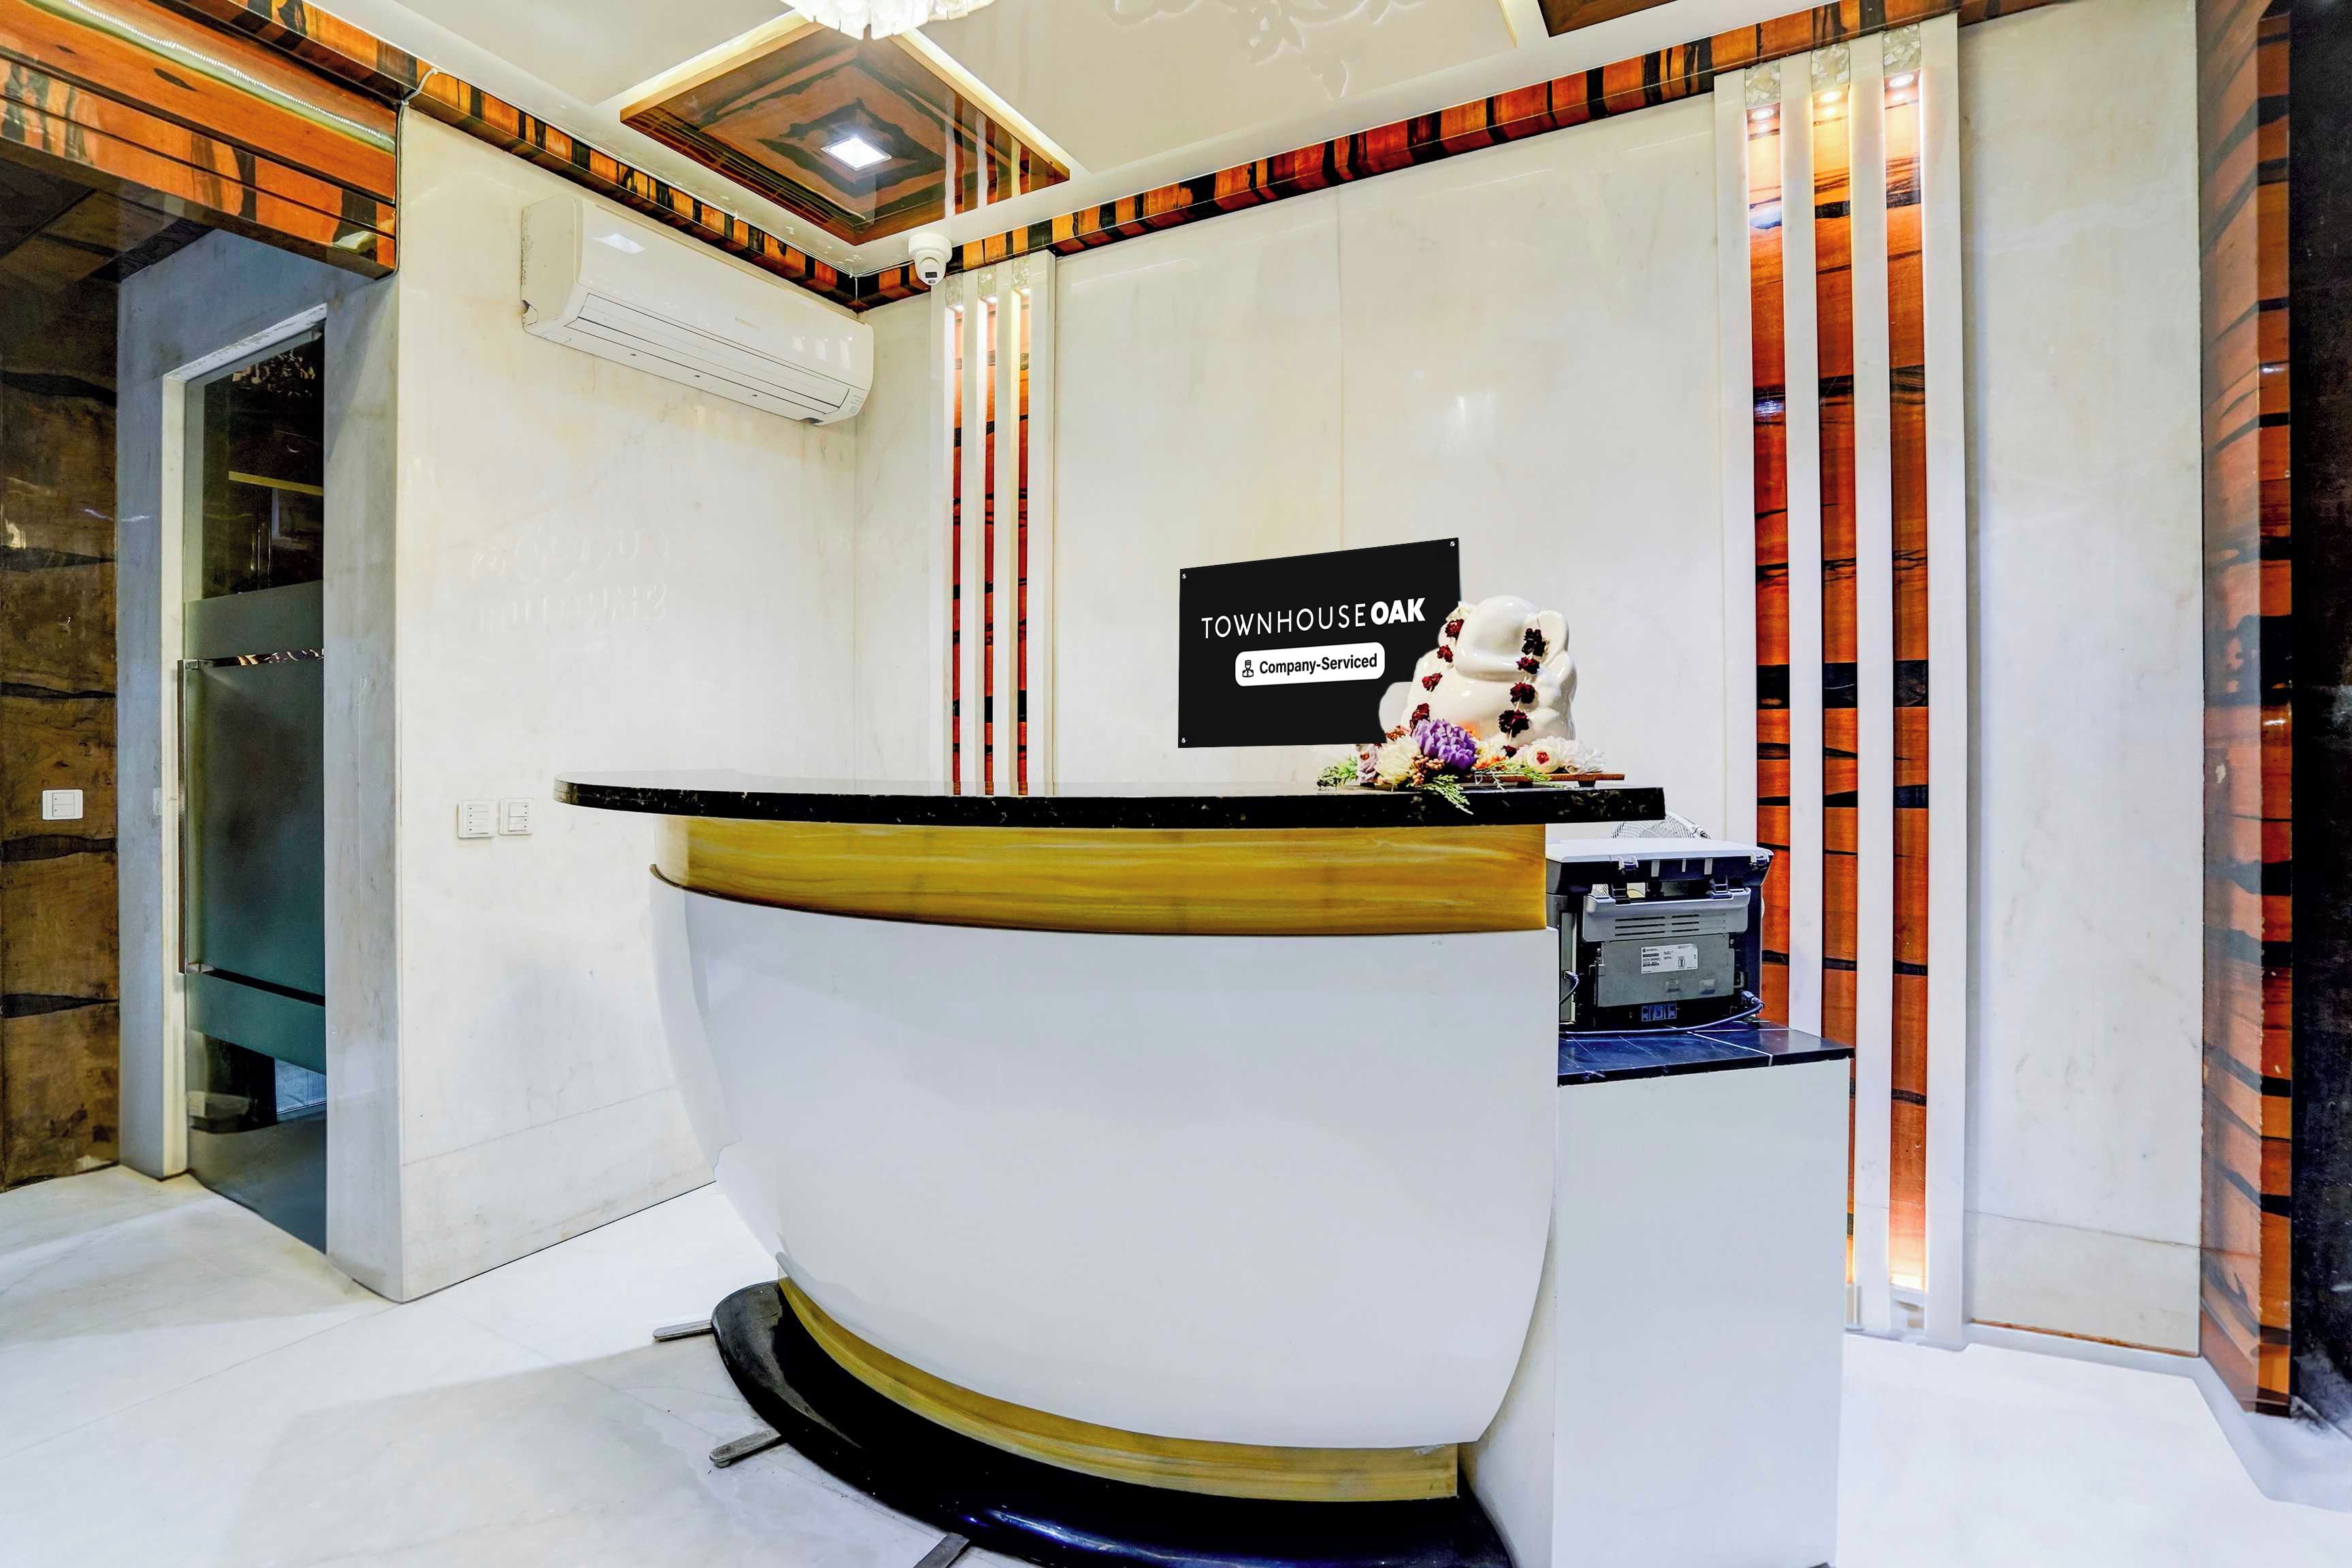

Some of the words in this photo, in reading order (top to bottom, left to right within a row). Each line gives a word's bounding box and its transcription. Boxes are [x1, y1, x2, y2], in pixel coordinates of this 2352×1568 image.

[1201, 602, 1366, 639] TOWNHOUSE
[1370, 598, 1426, 625] OAK
[1259, 653, 1377, 676] Company-Serviced
